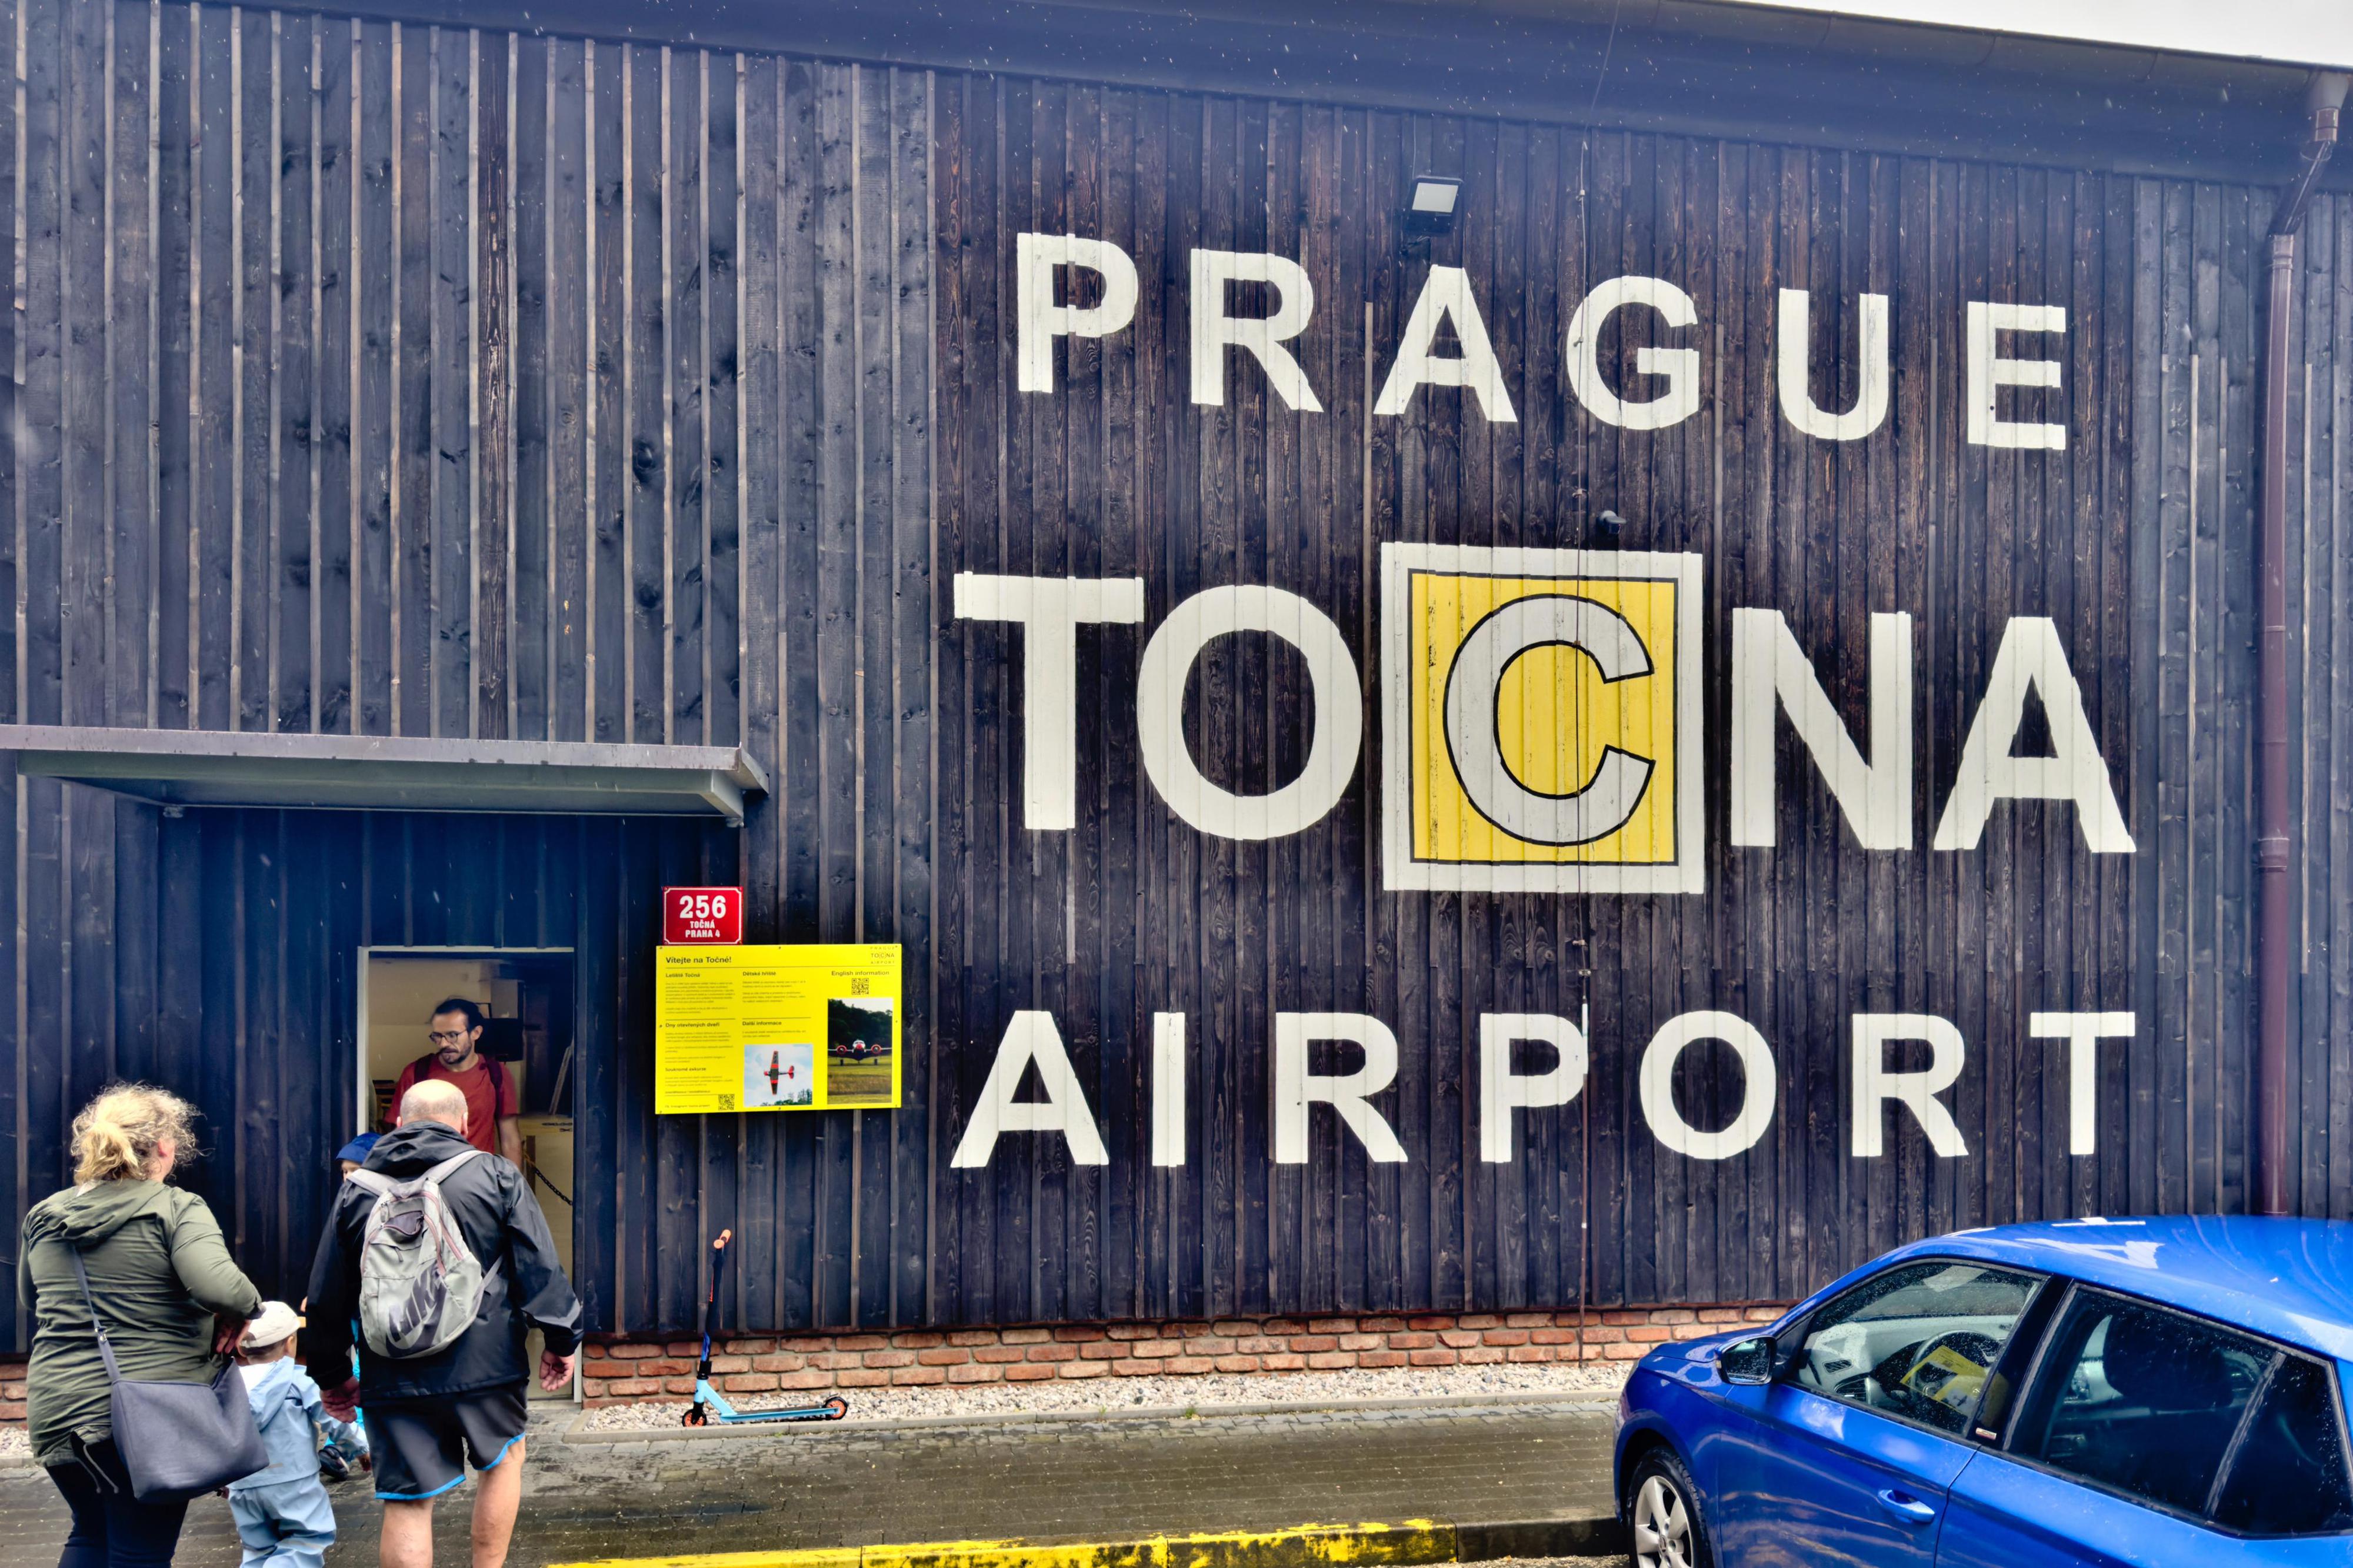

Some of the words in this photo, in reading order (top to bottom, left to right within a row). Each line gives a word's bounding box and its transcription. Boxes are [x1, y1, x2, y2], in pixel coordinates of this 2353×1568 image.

[1016, 231, 2068, 451] PRAGUE
[679, 895, 726, 919] 256
[690, 919, 715, 929] TOČNÁ
[685, 929, 713, 938] PRAHA
[665, 956, 691, 965] Vítejte
[949, 1008, 2137, 1170] AIRPORT
